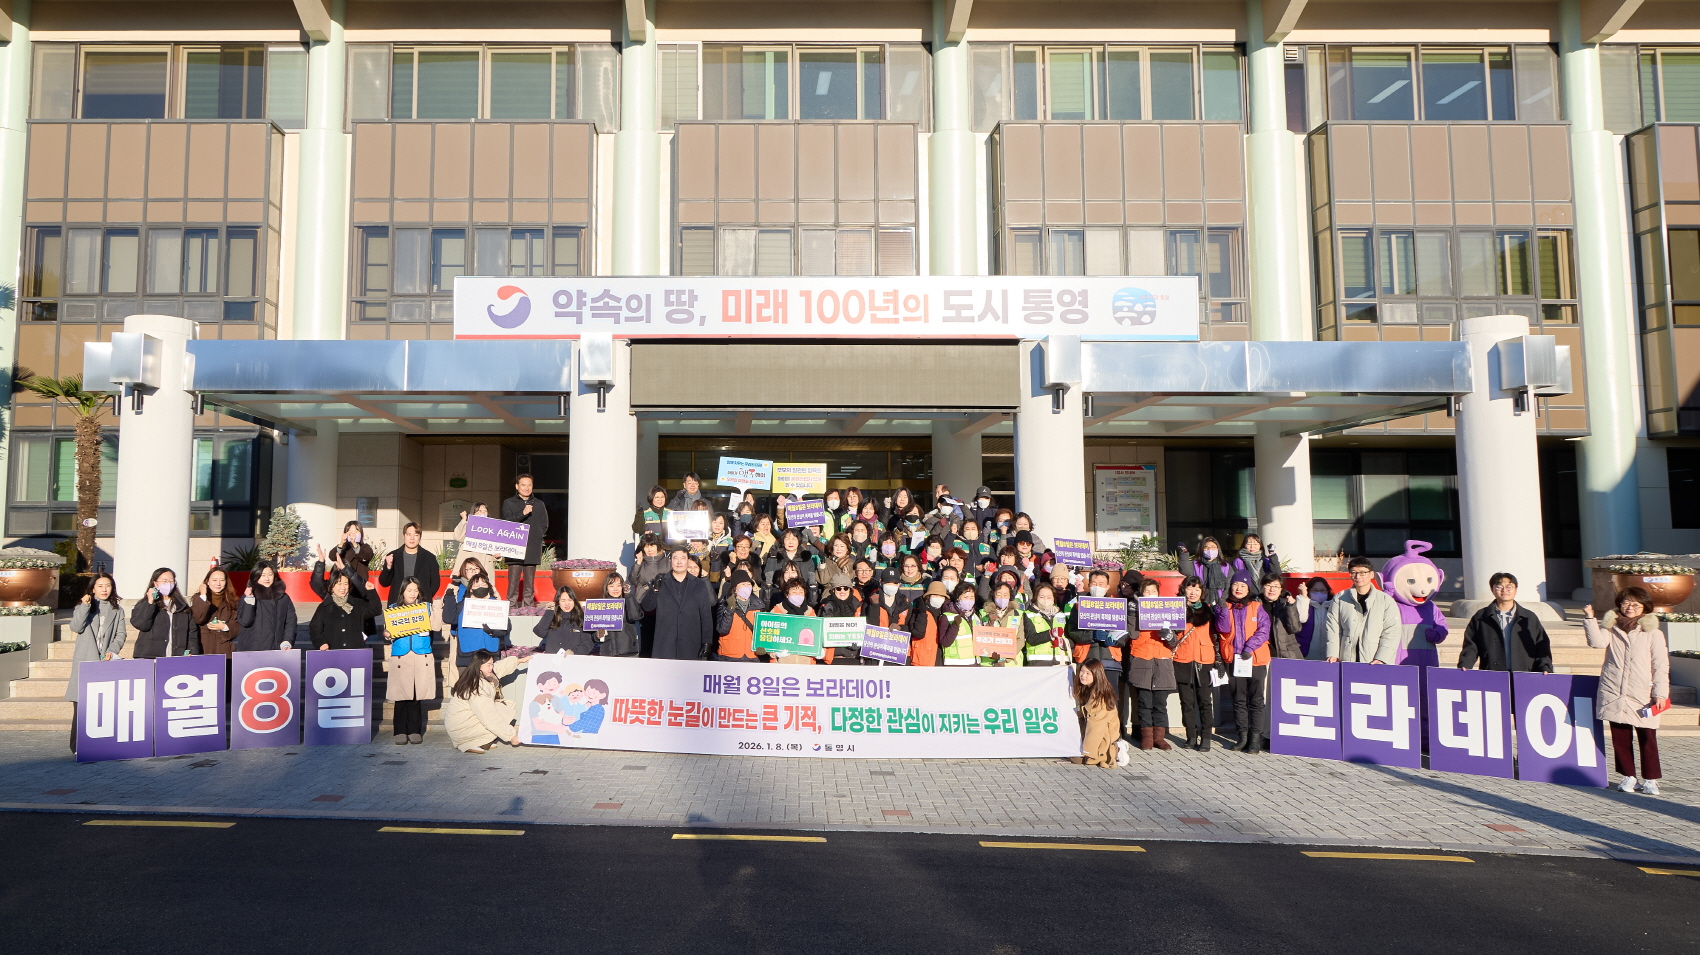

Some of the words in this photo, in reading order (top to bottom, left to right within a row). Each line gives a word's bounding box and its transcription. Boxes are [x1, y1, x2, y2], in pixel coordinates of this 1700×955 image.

[551, 288, 652, 326] 약속의
[663, 288, 708, 328] 땅,
[721, 288, 788, 325] 미래
[799, 288, 930, 325] 100년의
[942, 288, 1010, 325] 도시
[1022, 288, 1090, 325] 통영
[470, 525, 495, 535] LOOK
[497, 529, 525, 540] AGAIN
[760, 620, 787, 630] 아이들의
[702, 674, 741, 698] 매월
[747, 675, 800, 698] 8일은
[806, 677, 891, 700] 보라데이!
[612, 697, 663, 728] 따뜻한
[666, 699, 715, 729] 눈길이
[718, 707, 759, 732] 만드는
[761, 703, 780, 732] 큰
[783, 704, 822, 735] 기적,
[831, 706, 882, 735] 다정한
[886, 707, 935, 736] 관심이
[938, 711, 981, 736] 지키는
[984, 707, 1019, 736] 우리
[1022, 707, 1059, 736] 일상
[738, 741, 763, 751] 2026.
[767, 741, 773, 751] 1.
[775, 742, 784, 751] 8.
[785, 741, 803, 752] (목)
